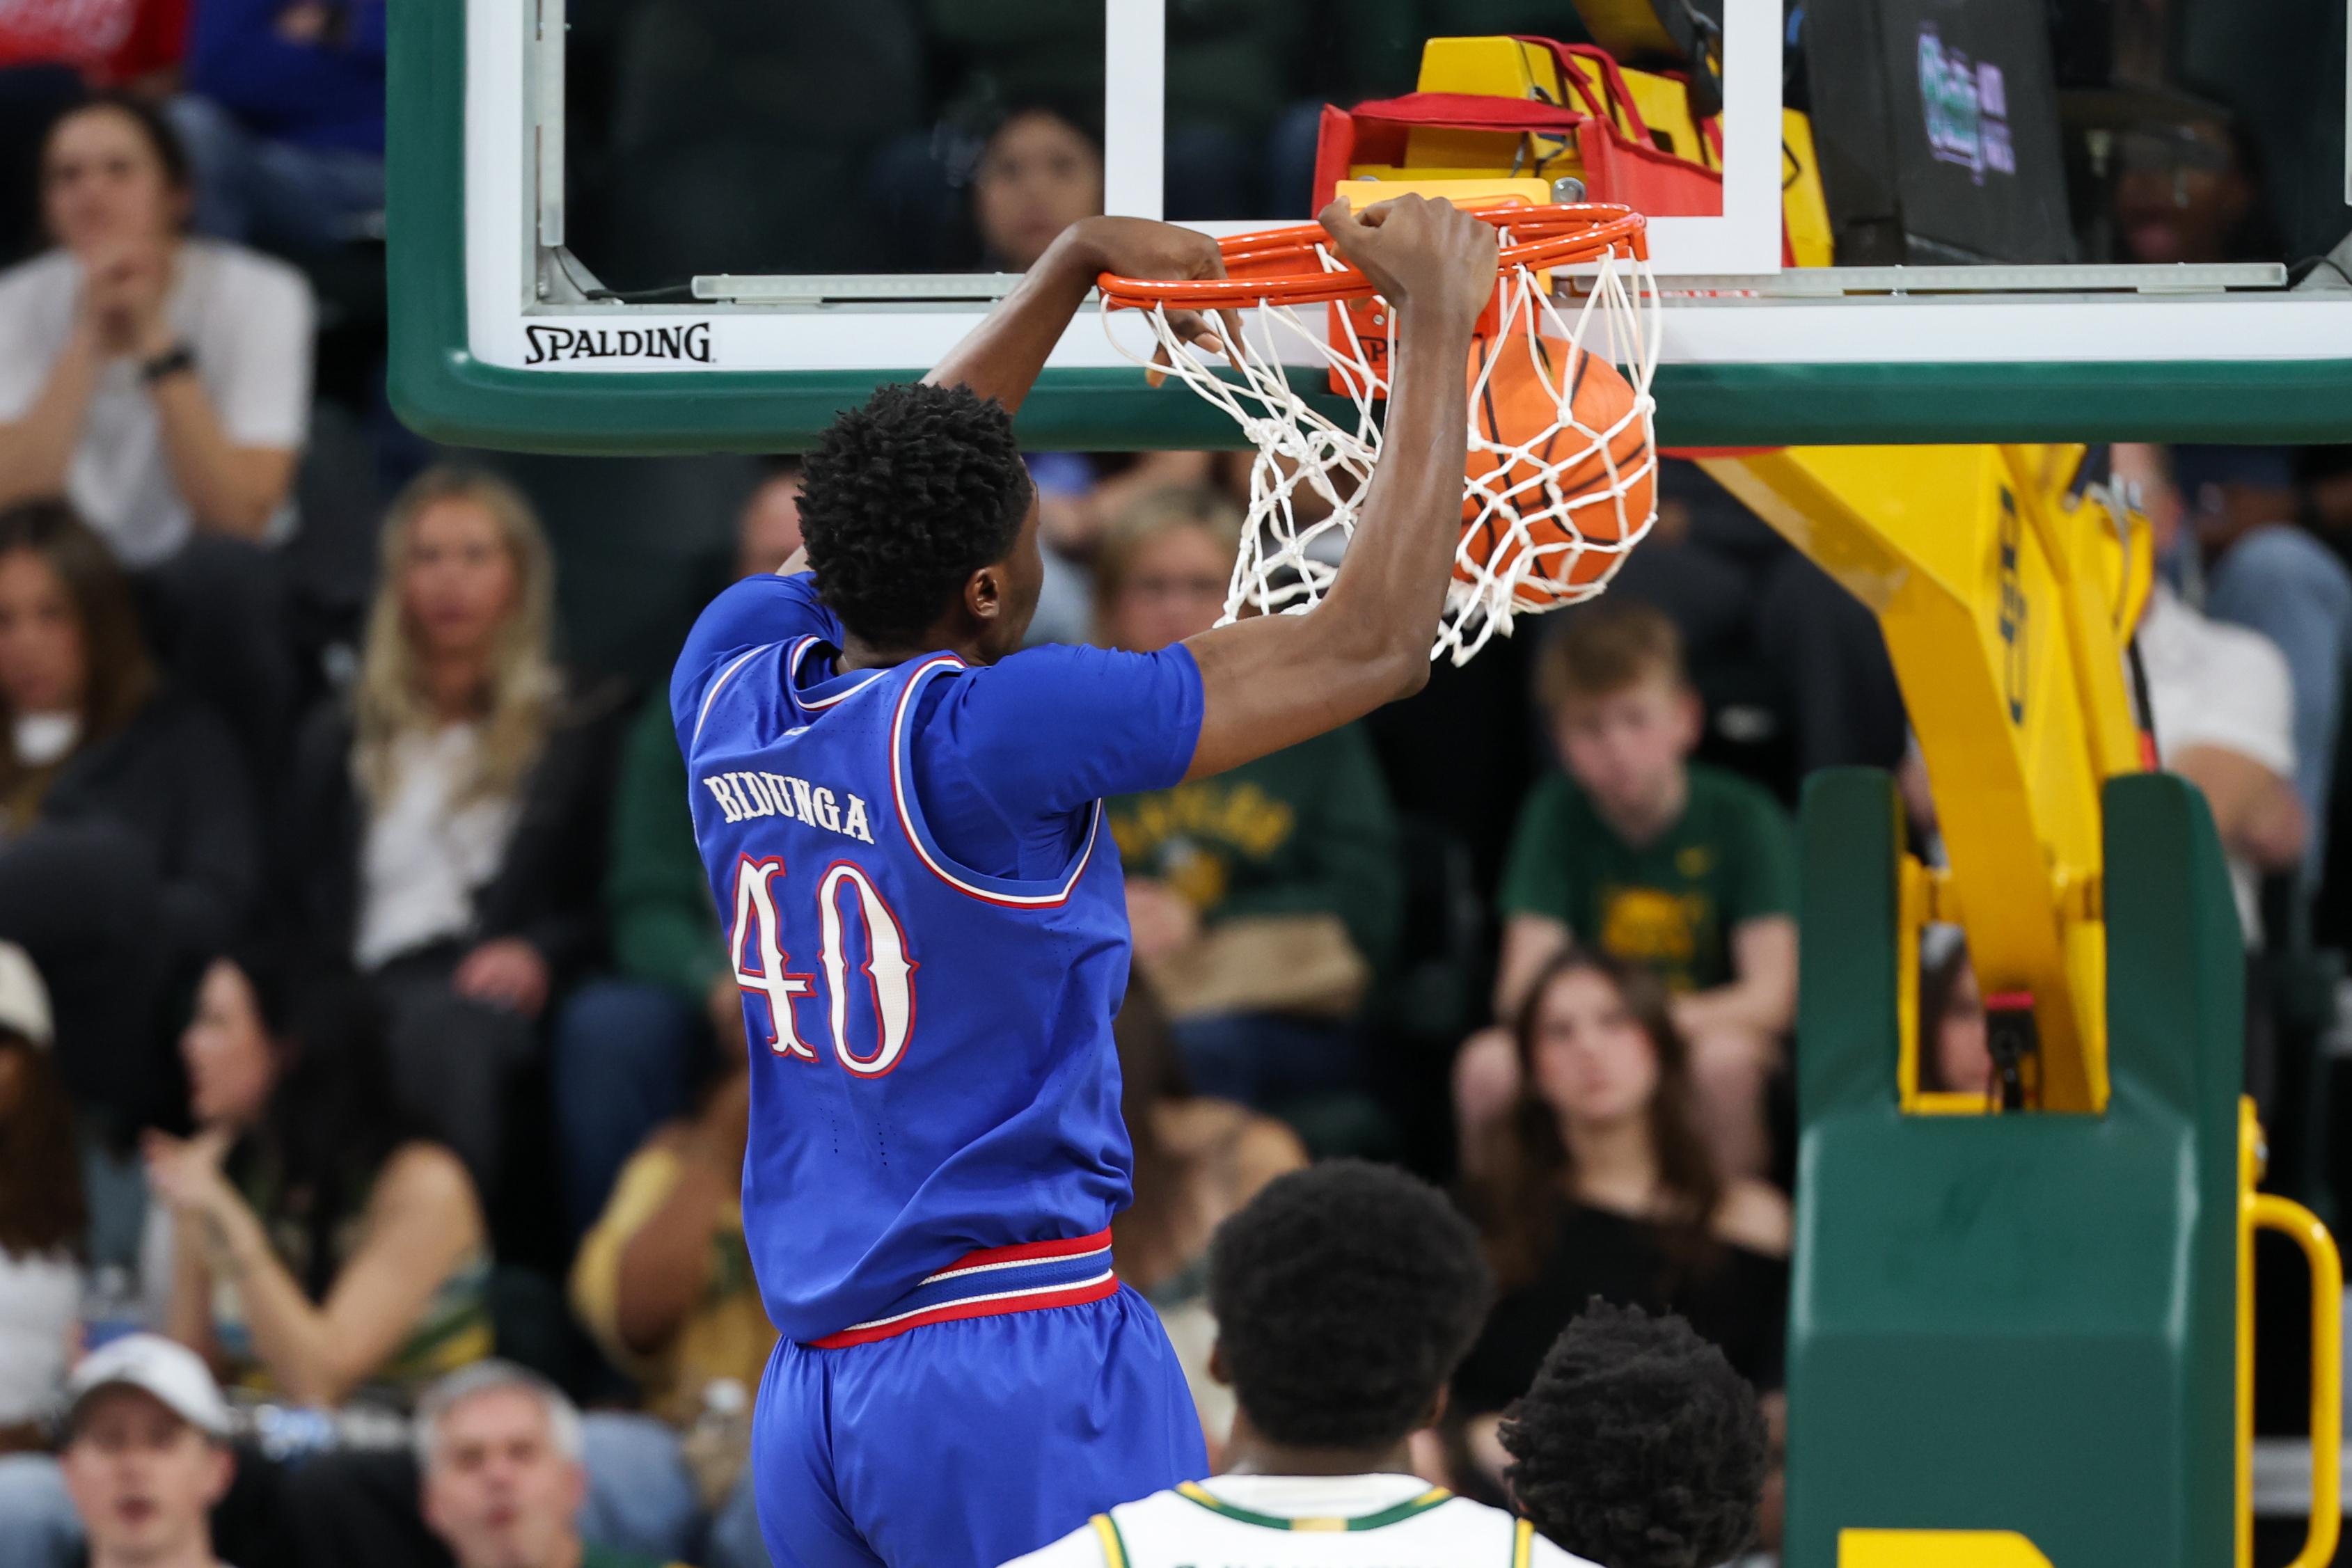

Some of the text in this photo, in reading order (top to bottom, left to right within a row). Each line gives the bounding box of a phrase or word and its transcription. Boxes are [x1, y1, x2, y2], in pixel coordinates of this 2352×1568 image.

[526, 322, 710, 365] SPALDING
[702, 770, 875, 845] BIDUNGA
[729, 852, 920, 1079] 40
